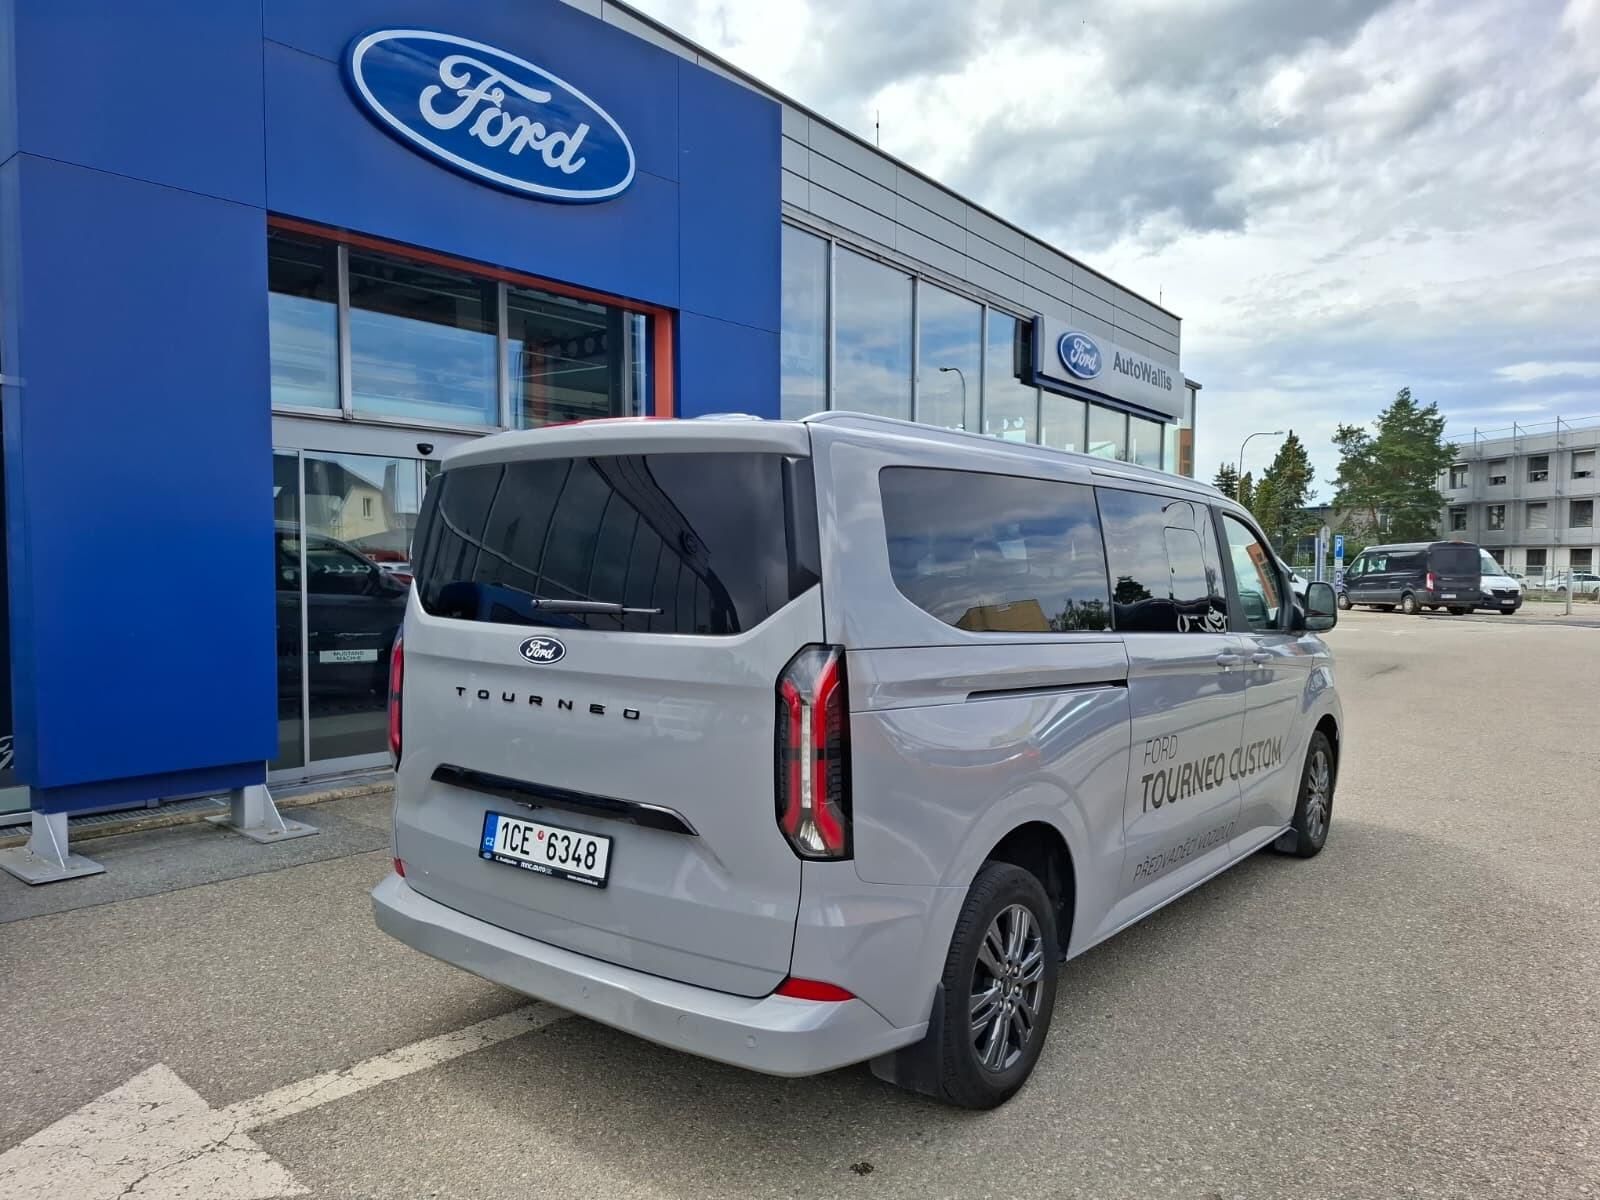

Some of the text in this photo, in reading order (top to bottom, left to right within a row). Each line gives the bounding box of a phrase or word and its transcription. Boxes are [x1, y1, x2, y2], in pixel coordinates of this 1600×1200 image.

[419, 54, 590, 174] Ford
[1070, 337, 1172, 391] Ford AutoWallis
[525, 639, 555, 659] Ford
[456, 686, 640, 720] TOURNEO
[1141, 736, 1283, 813] TOURNEO CUSTOM
[1143, 735, 1178, 766] FORD
[501, 822, 597, 870] 1CE 6348
